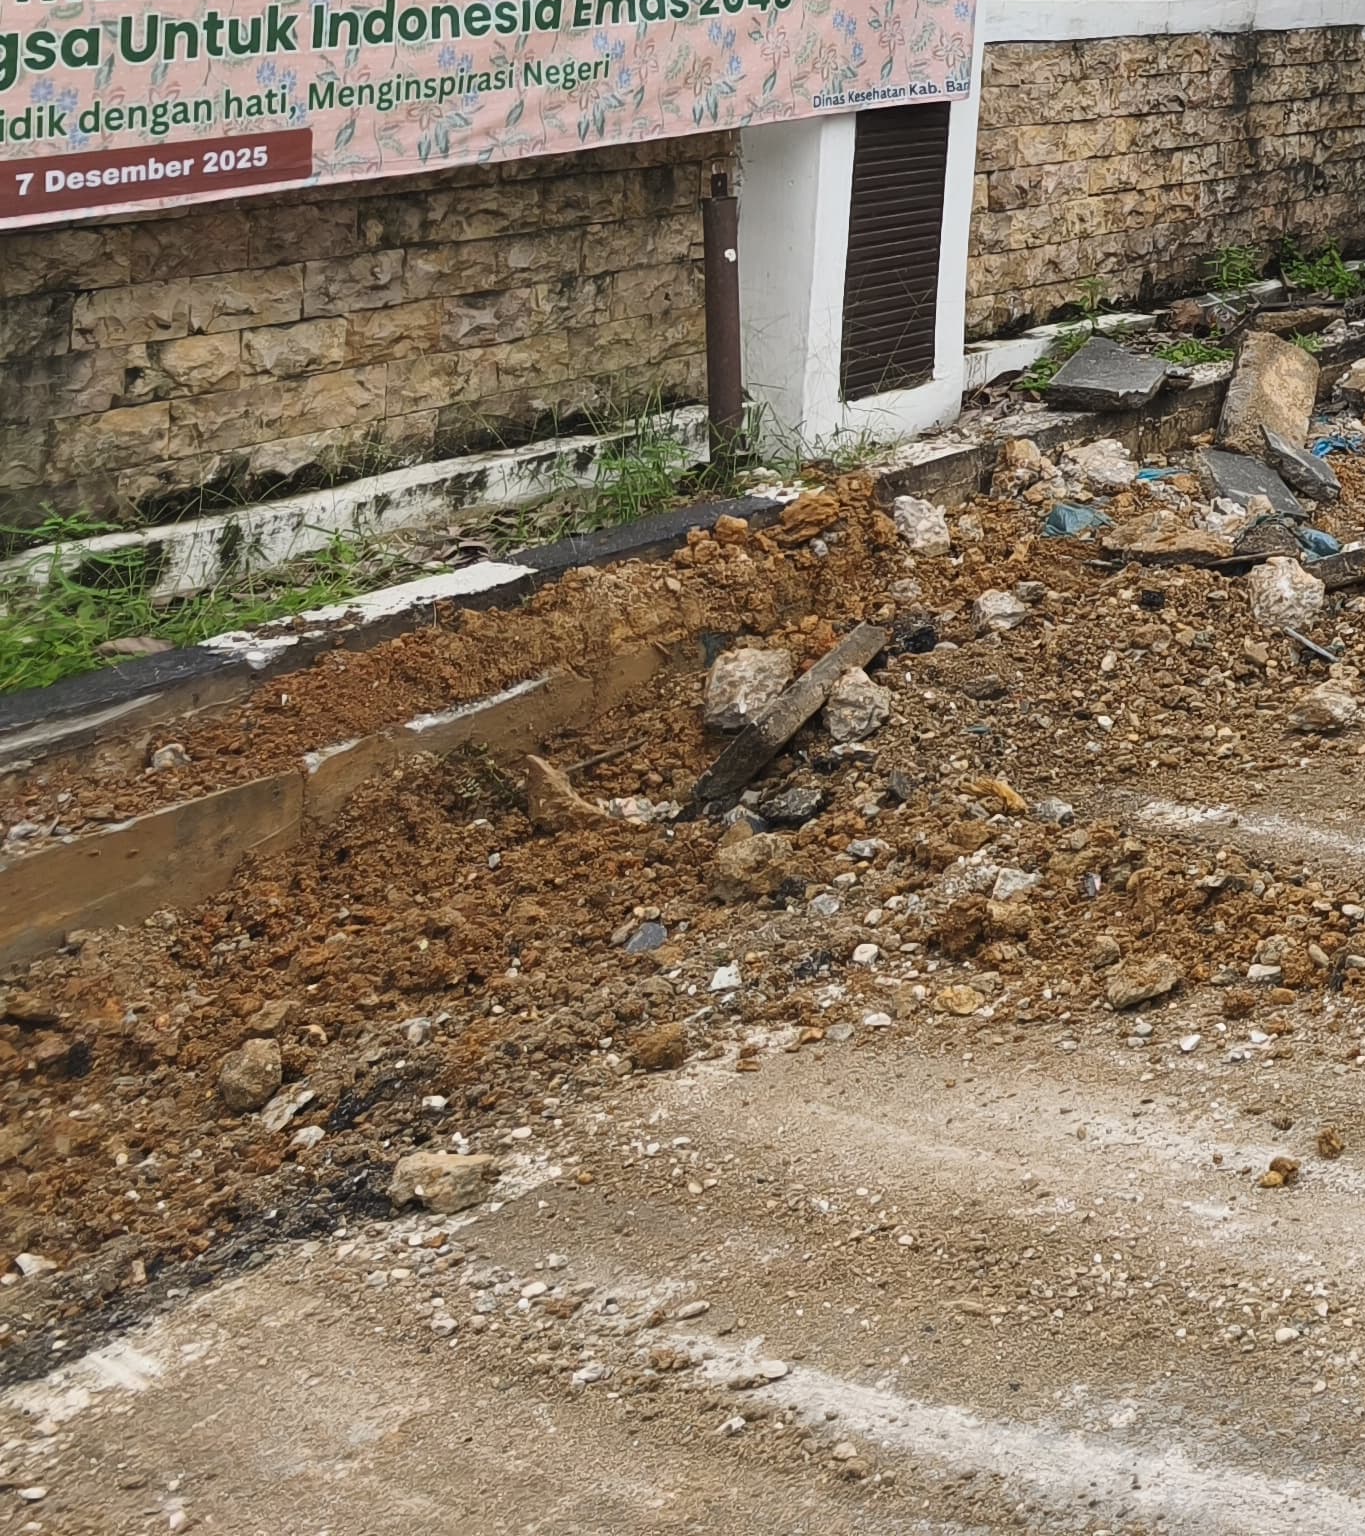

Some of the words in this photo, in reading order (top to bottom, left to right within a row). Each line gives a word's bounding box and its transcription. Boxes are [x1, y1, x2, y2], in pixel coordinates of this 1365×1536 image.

[120, 4, 298, 65] Untuk
[78, 96, 213, 136] dengan
[224, 83, 297, 120] hati,
[308, 58, 514, 114] Menginspirasi
[523, 53, 611, 90] Negeri
[813, 95, 845, 108] Dinas
[848, 87, 906, 103] Kesehatan
[909, 81, 942, 96] Kab.
[16, 173, 33, 195] 7
[45, 157, 194, 193] Desember
[202, 146, 268, 175] 2025
